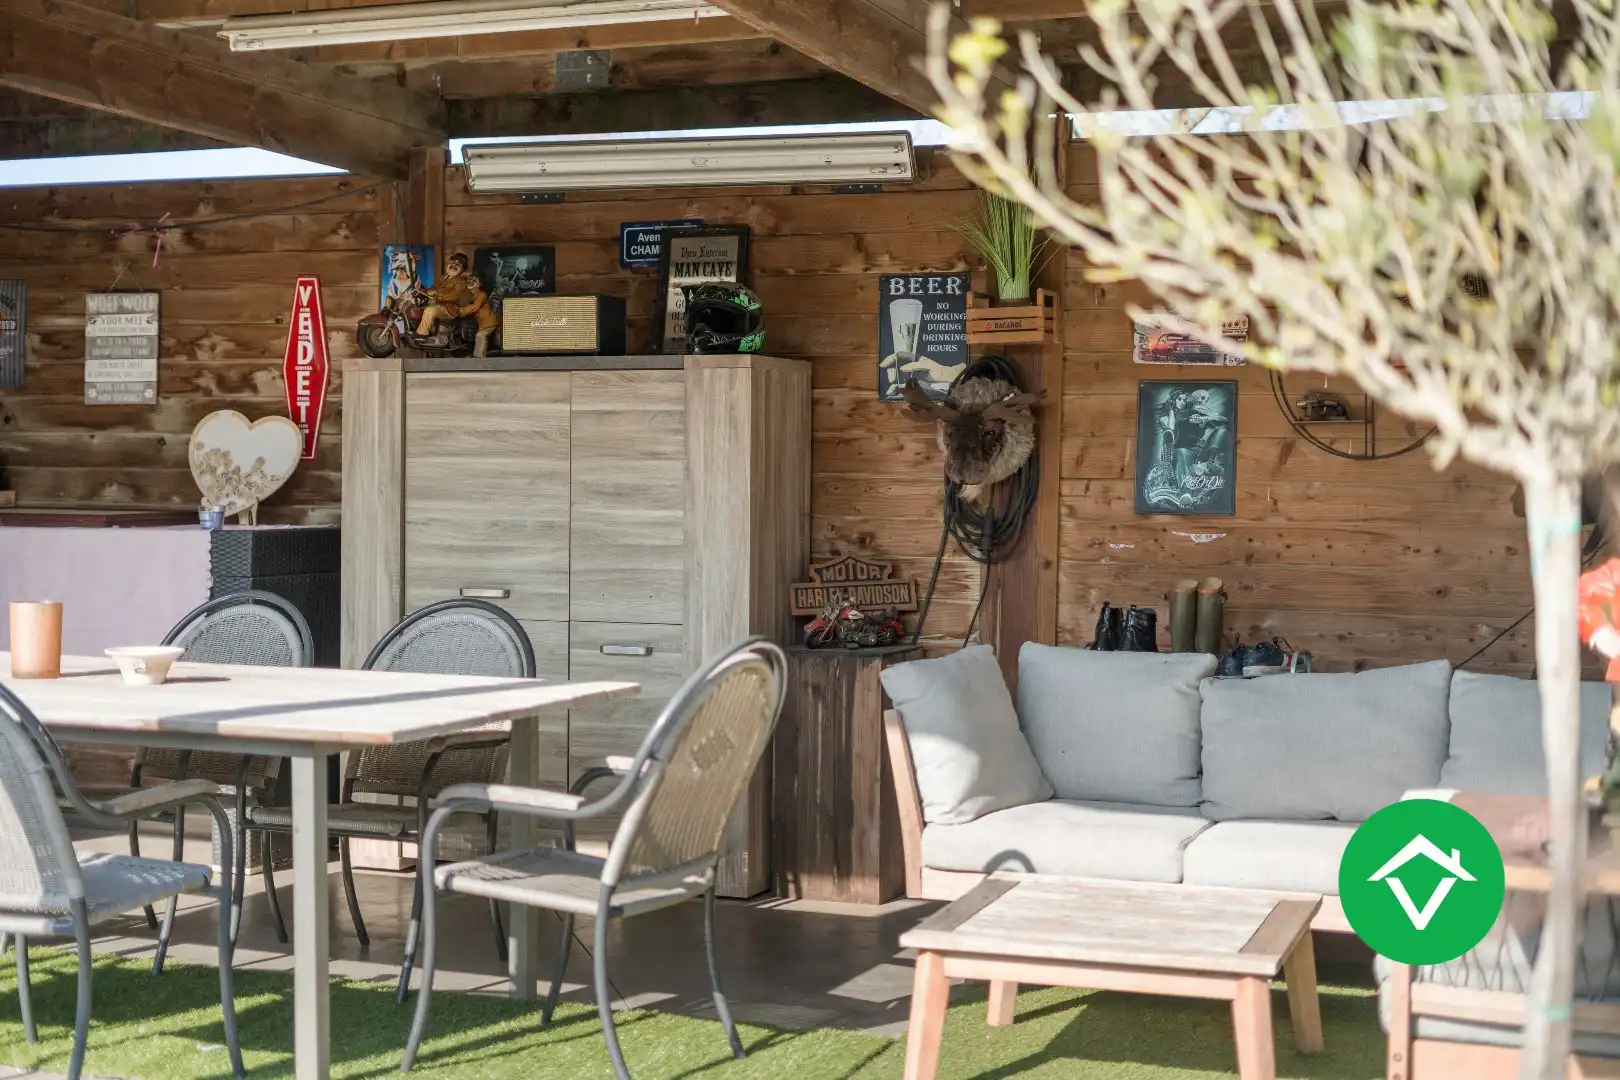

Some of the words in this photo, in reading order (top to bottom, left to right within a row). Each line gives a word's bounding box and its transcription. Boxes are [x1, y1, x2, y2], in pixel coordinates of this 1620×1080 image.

[637, 232, 661, 242] Aven
[674, 261, 700, 277] MAN
[703, 261, 733, 277] CAVE
[889, 276, 963, 296] BEER
[936, 302, 950, 310] NO
[923, 313, 967, 321] WORKING
[927, 323, 962, 331] DURING
[922, 333, 968, 341] DRINKING
[822, 559, 881, 582] MOTOR
[797, 584, 910, 609] HARLEY-DAVIDSON
